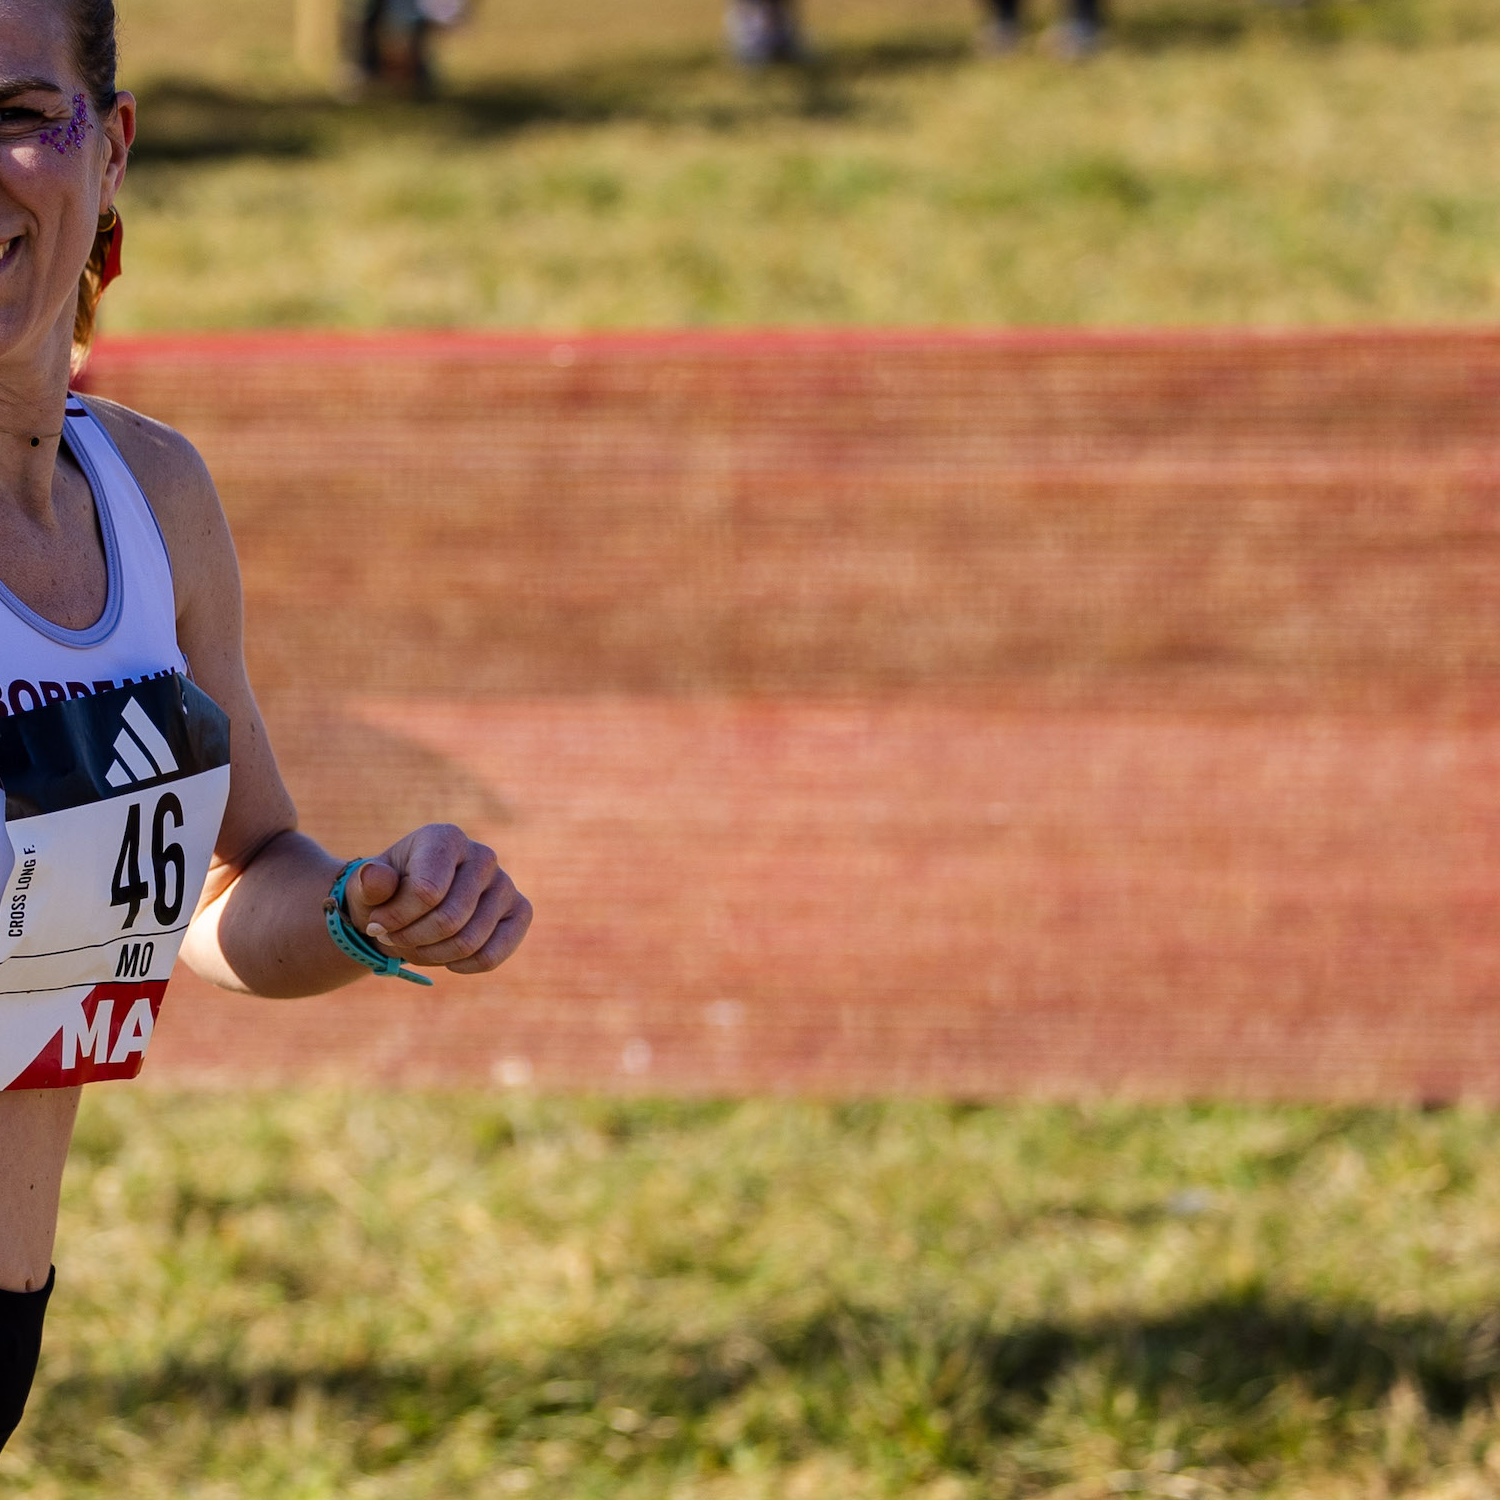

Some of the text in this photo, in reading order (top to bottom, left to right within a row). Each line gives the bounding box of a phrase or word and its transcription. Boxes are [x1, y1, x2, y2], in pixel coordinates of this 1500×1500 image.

[8, 844, 37, 937] CROSS LONG F.
[109, 791, 186, 930] 46
[115, 941, 155, 978] MO
